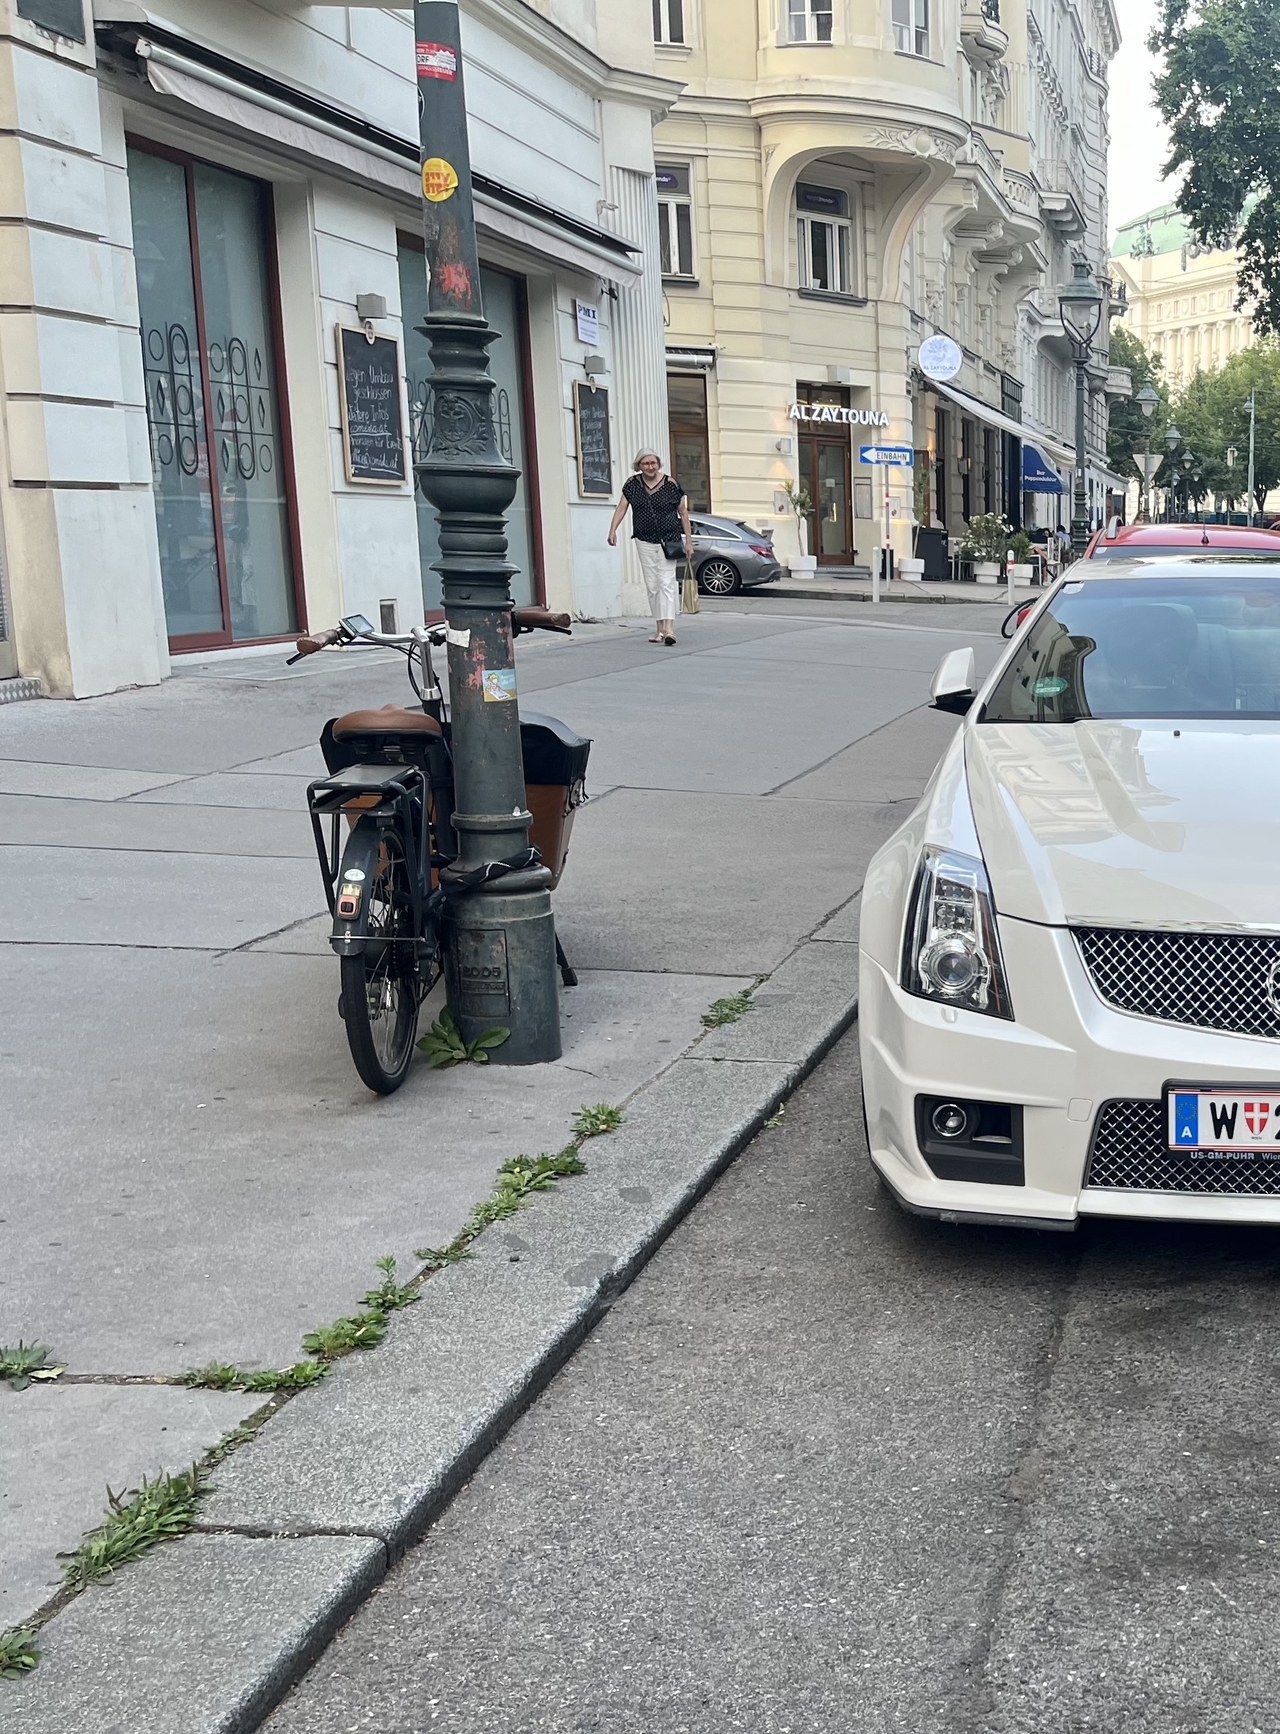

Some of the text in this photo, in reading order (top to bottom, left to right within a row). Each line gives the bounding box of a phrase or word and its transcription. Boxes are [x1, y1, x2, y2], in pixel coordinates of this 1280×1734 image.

[577, 303, 597, 320] PMI
[790, 404, 890, 426] AL ZAYTOUNA
[876, 452, 908, 461] EINBAHN
[1181, 1126, 1193, 1138] A
[1210, 1102, 1238, 1139] W
[1190, 1151, 1255, 1160] US-GM-PUHR
